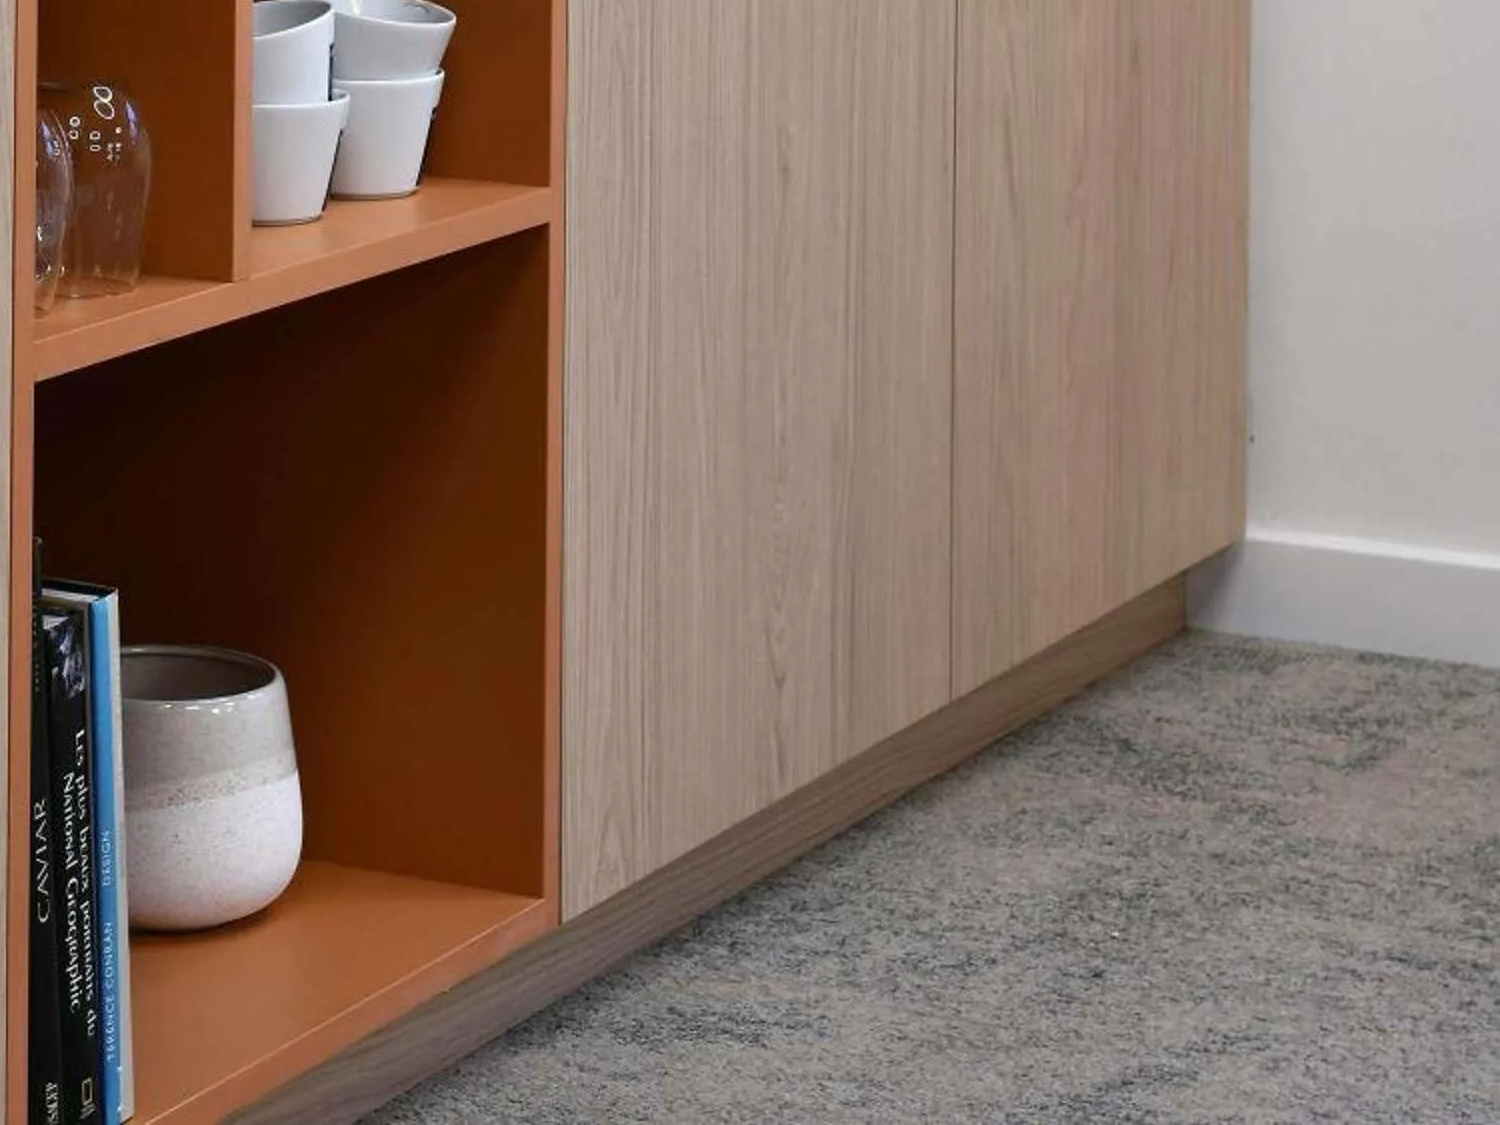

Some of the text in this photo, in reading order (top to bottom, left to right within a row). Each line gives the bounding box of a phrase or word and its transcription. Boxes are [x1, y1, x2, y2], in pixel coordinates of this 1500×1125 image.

[76, 775, 88, 819] plus
[34, 797, 51, 923] CAVIAR
[80, 826, 89, 892] beaux
[101, 830, 112, 887] DESIGN
[102, 922, 115, 990] CONRAN
[87, 1009, 97, 1036] du
